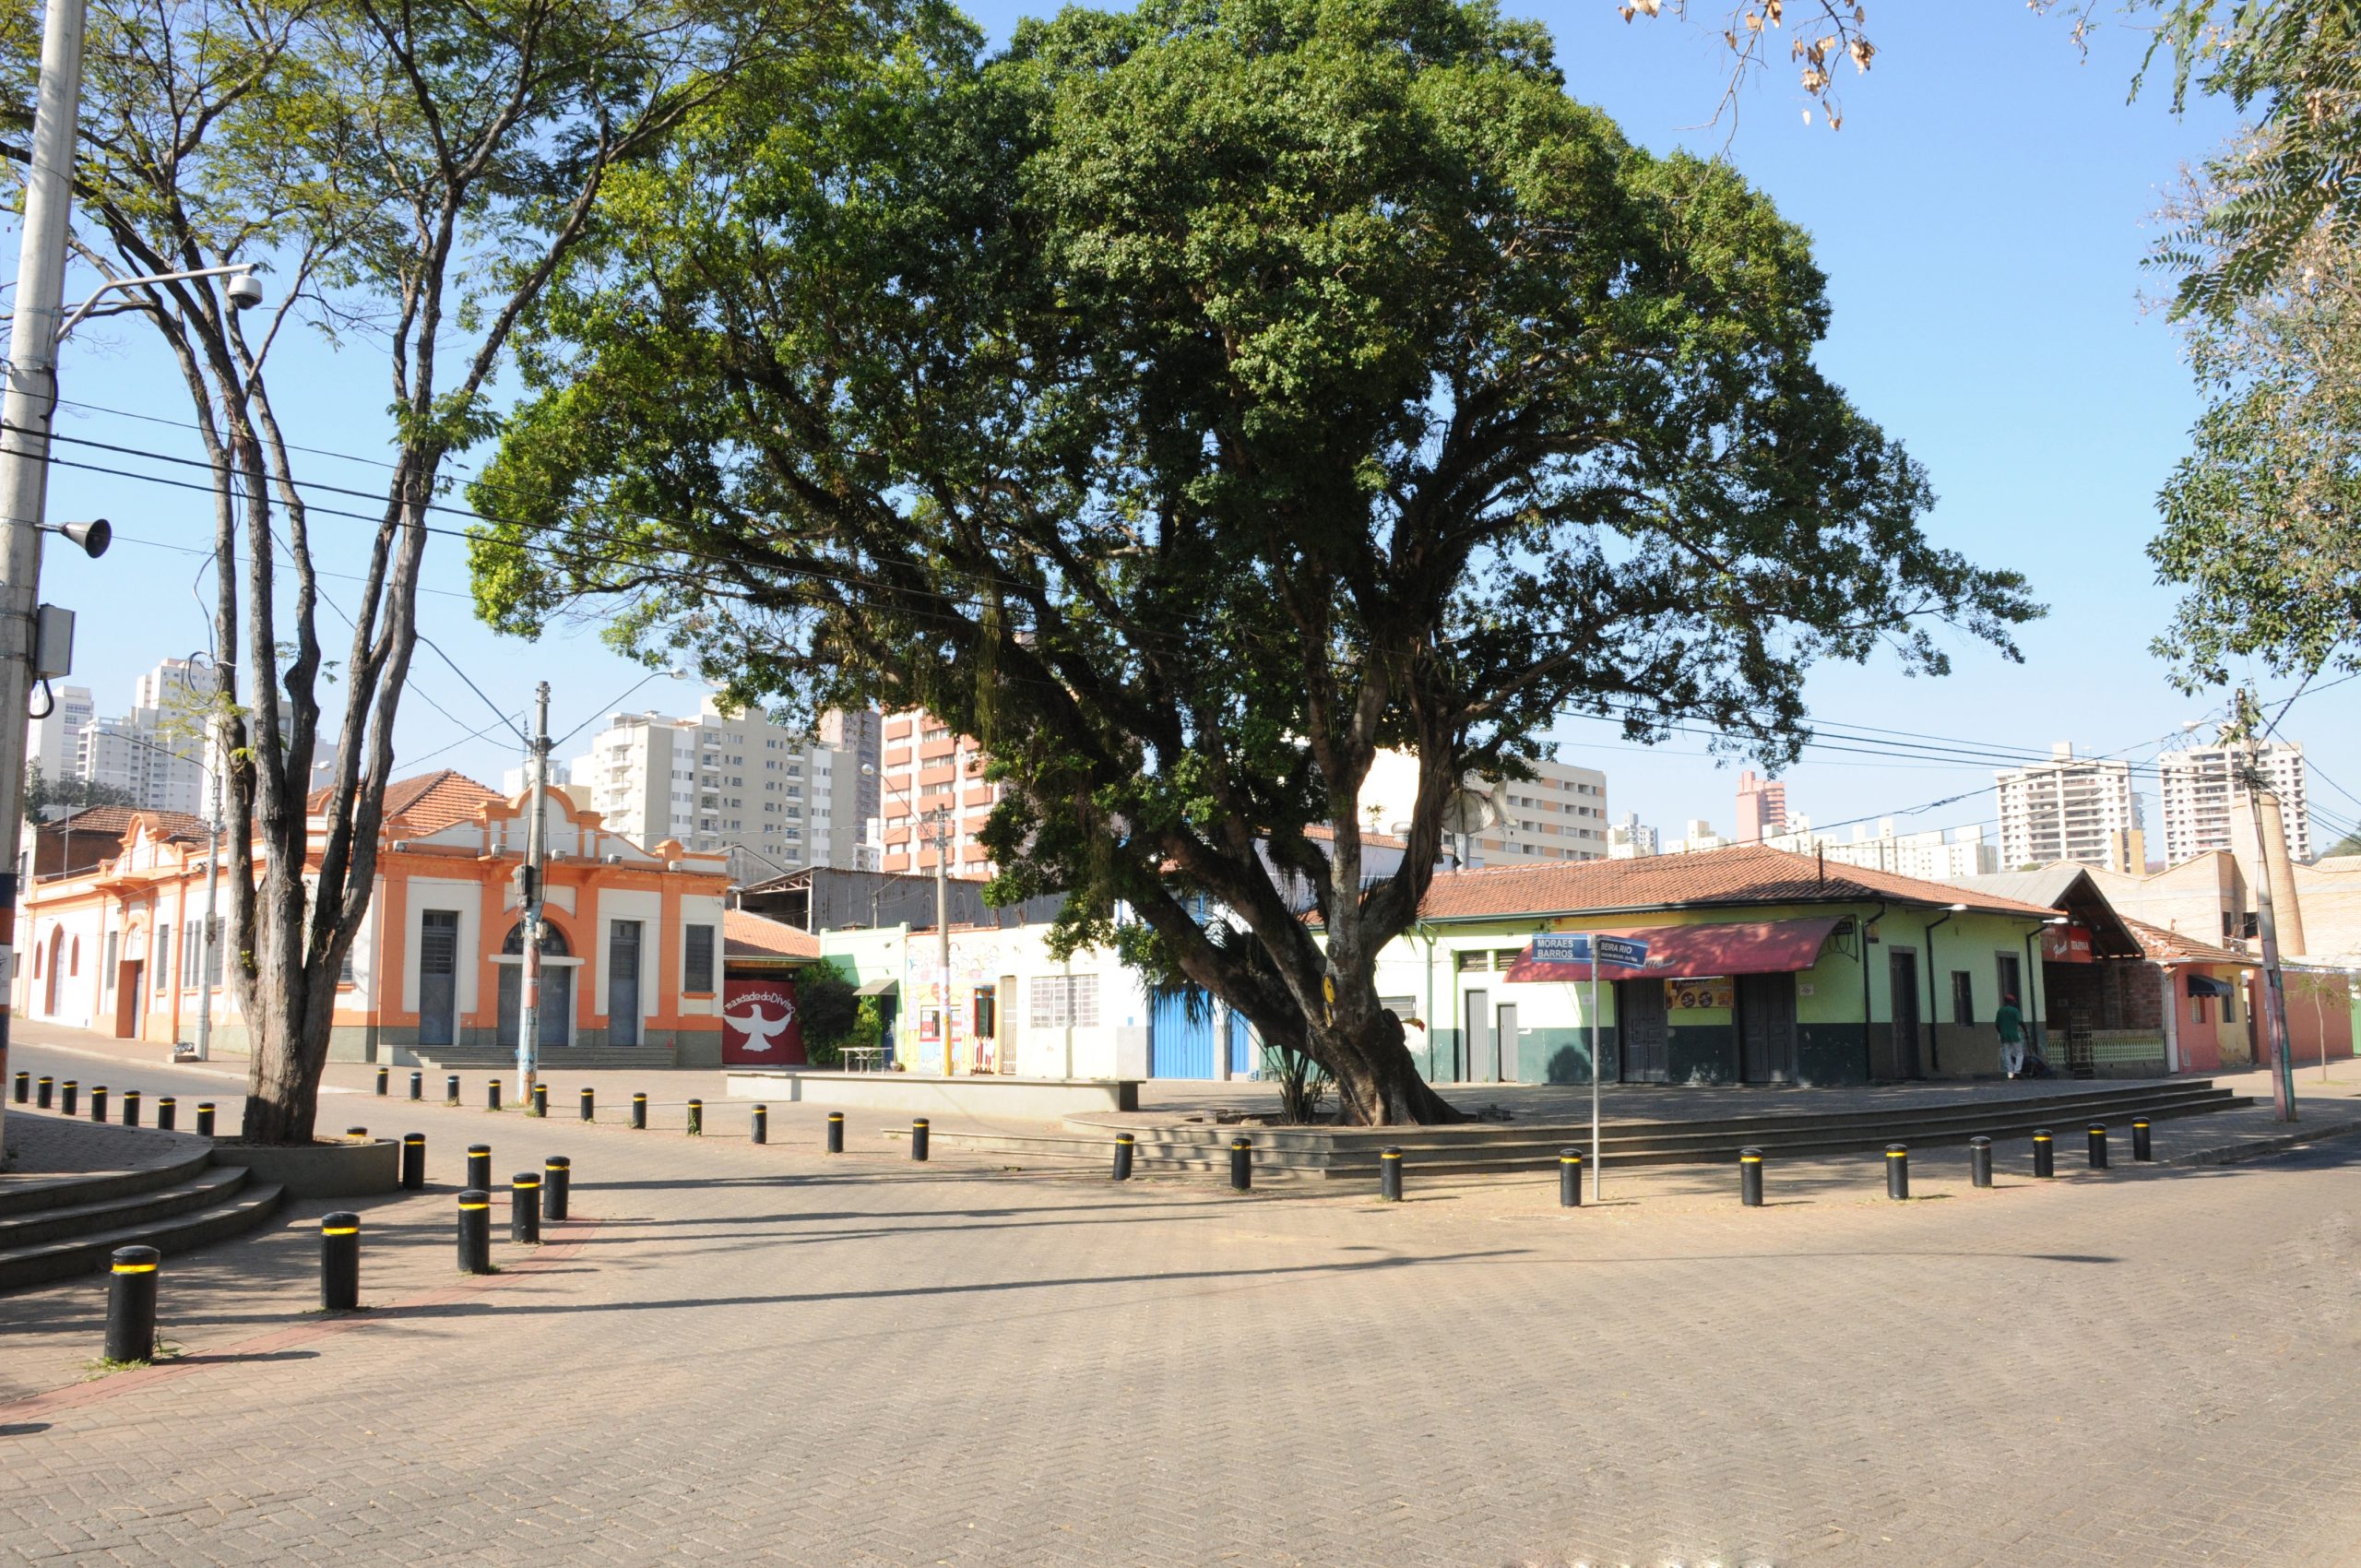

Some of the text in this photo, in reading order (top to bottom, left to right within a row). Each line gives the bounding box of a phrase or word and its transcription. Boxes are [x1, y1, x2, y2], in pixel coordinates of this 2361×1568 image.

[1537, 939, 1573, 948] MORAES
[1600, 942, 1632, 955] BEIRA RIO
[1537, 949, 1573, 958] BARROS
[771, 992, 796, 1014] Divino
